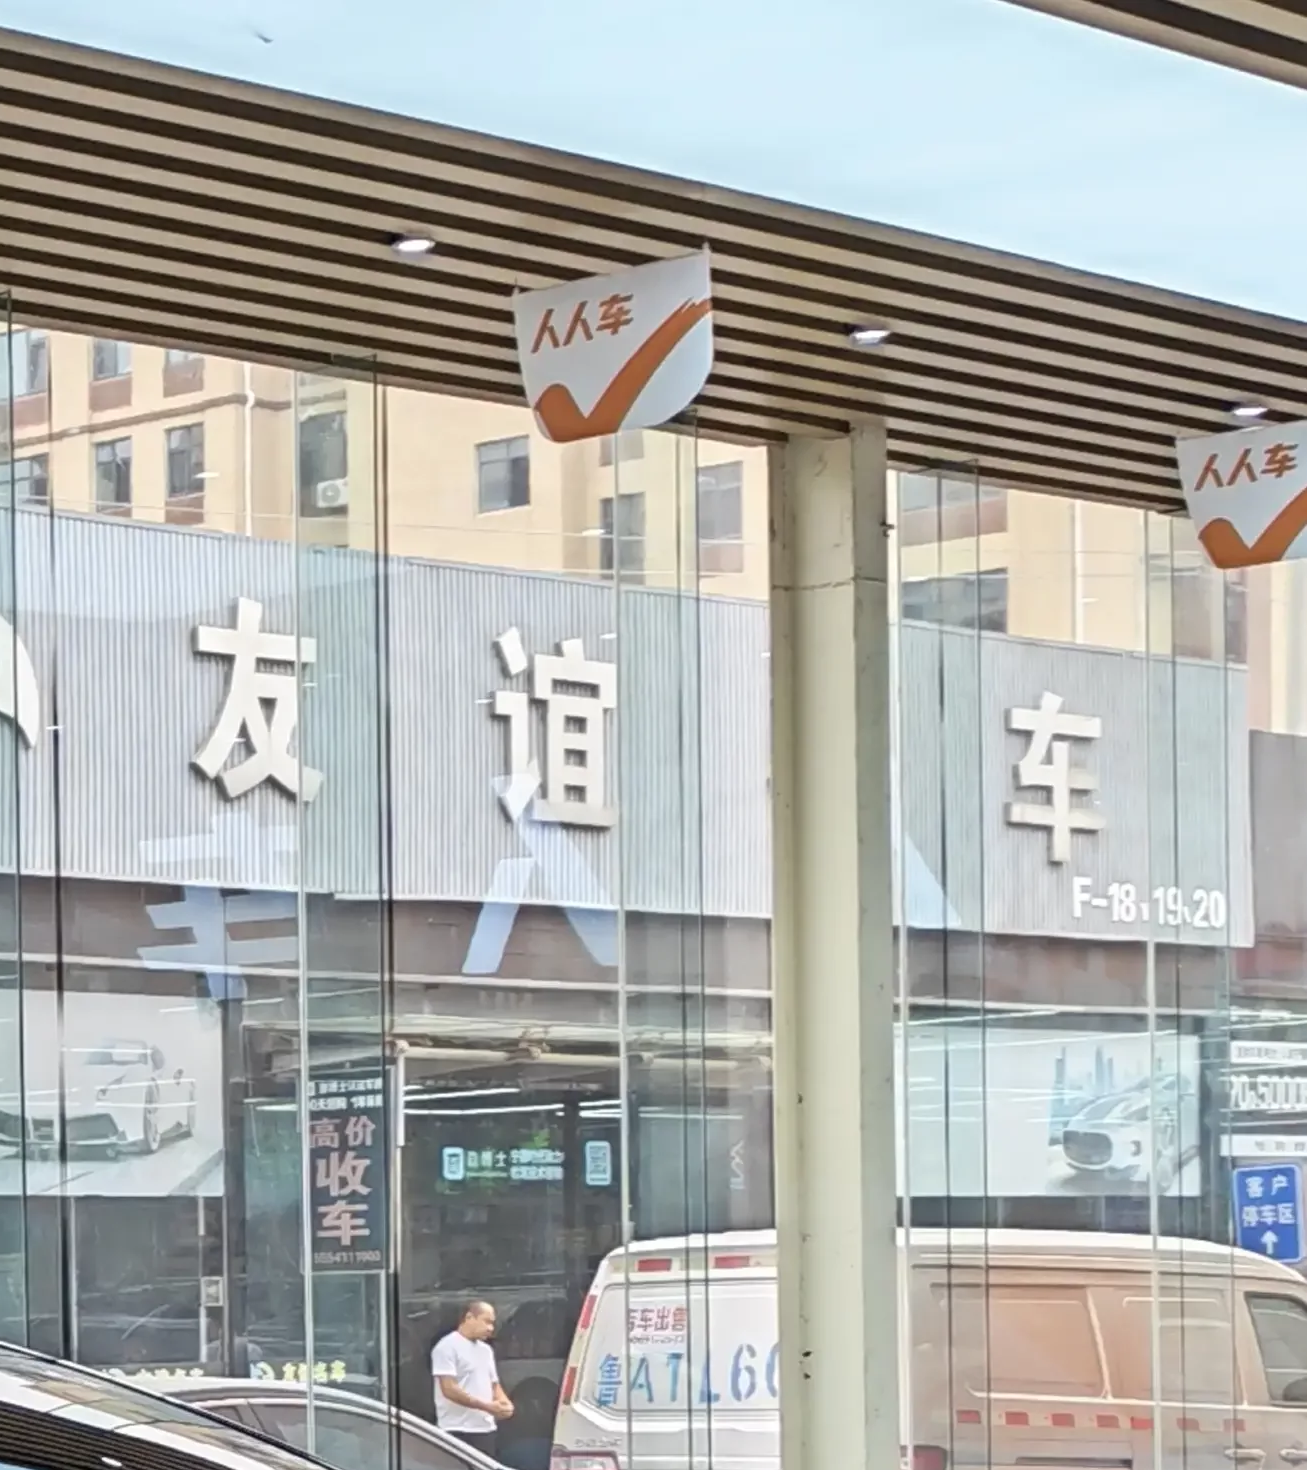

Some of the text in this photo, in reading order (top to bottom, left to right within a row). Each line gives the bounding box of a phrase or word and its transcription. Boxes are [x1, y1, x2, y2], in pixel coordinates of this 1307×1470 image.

[531, 293, 634, 354] 人人车
[1194, 441, 1299, 492] 人人车
[309, 1115, 376, 1149] 高价
[315, 1151, 373, 1246] 收车
[1245, 1174, 1289, 1198] 客户
[1242, 1202, 1295, 1227] 停车区
